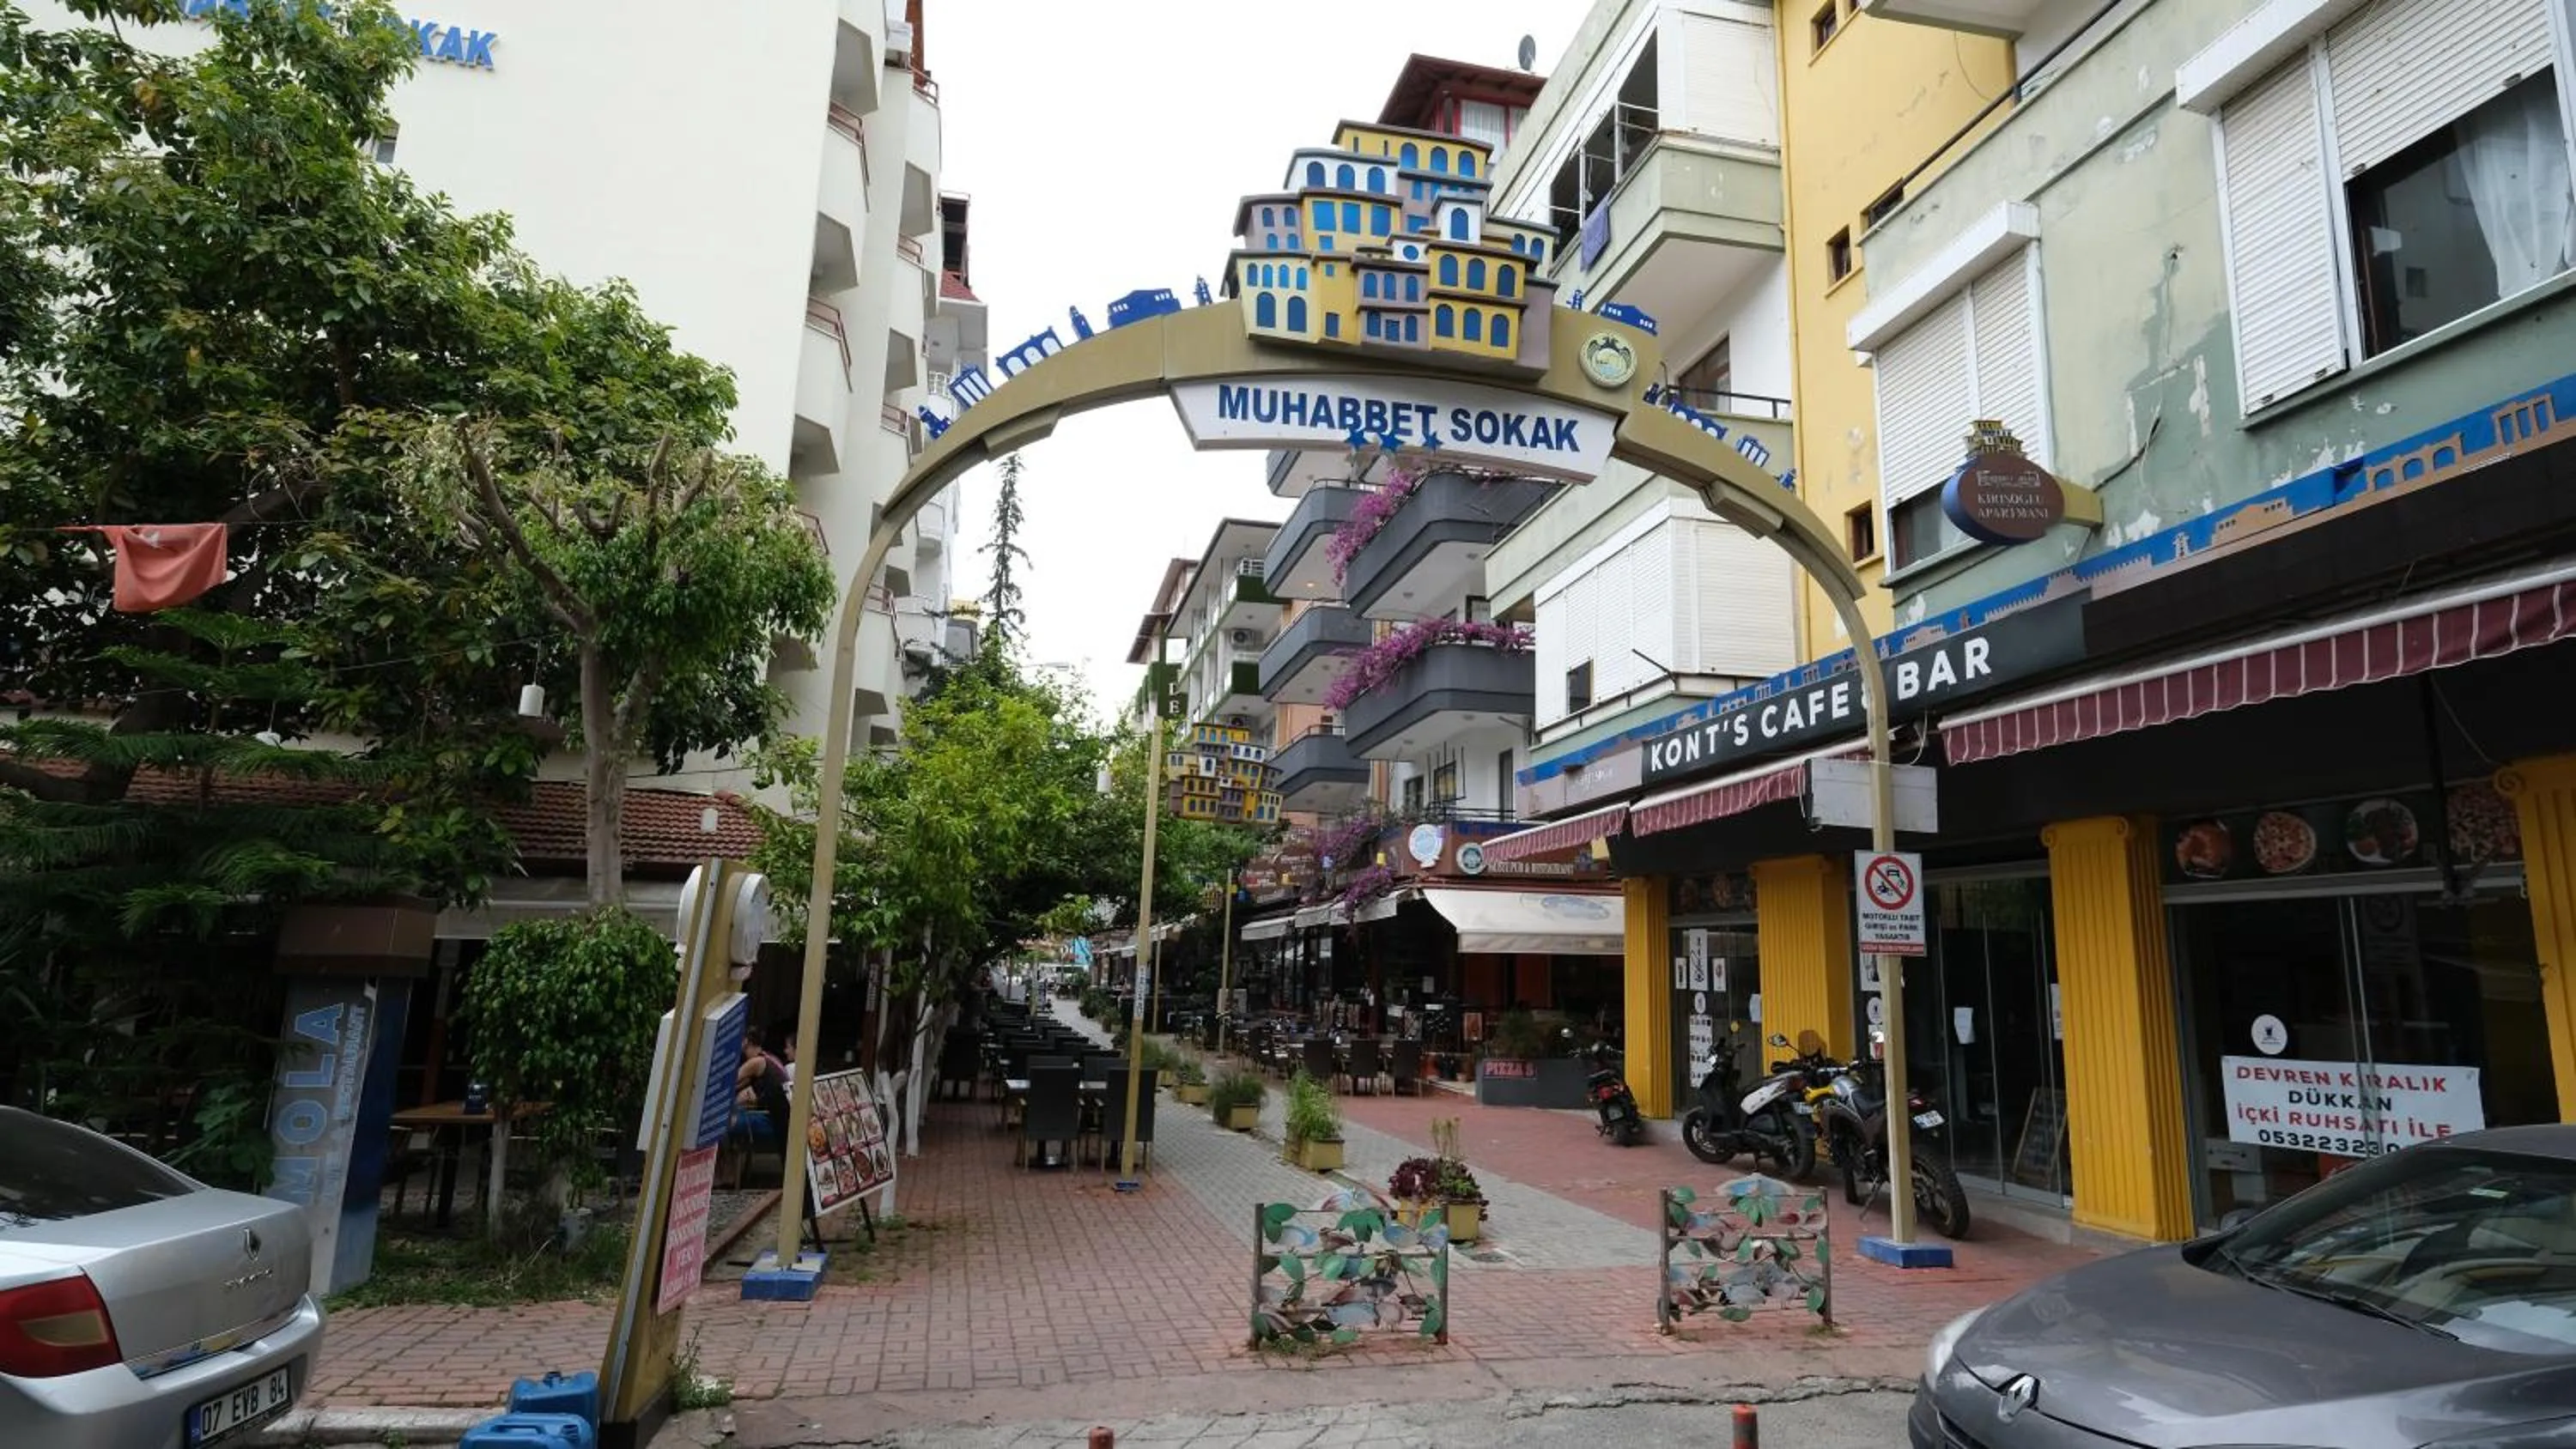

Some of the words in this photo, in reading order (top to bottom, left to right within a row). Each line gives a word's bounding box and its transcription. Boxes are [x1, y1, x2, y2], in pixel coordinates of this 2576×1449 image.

[380, 12, 497, 70] KAK
[1218, 383, 1438, 439] MUHABBET
[1450, 407, 1581, 453] SOKAK
[1650, 712, 1750, 773] KONT'S
[1760, 680, 1850, 738] CAFE
[1896, 635, 1993, 701] BAR
[1486, 1061, 1522, 1076] PIZZA
[2237, 1065, 2331, 1086] DEVREN
[2339, 1071, 2446, 1093] KIRALIK
[267, 1002, 344, 1204] MOLA
[2237, 1102, 2280, 1125] İÇKİ
[2288, 1112, 2398, 1136] RUHSATI
[2408, 1117, 2452, 1138] İLE
[2288, 1088, 2392, 1112] DÜKKAN
[202, 1400, 222, 1435] 07
[270, 1374, 284, 1403] 84
